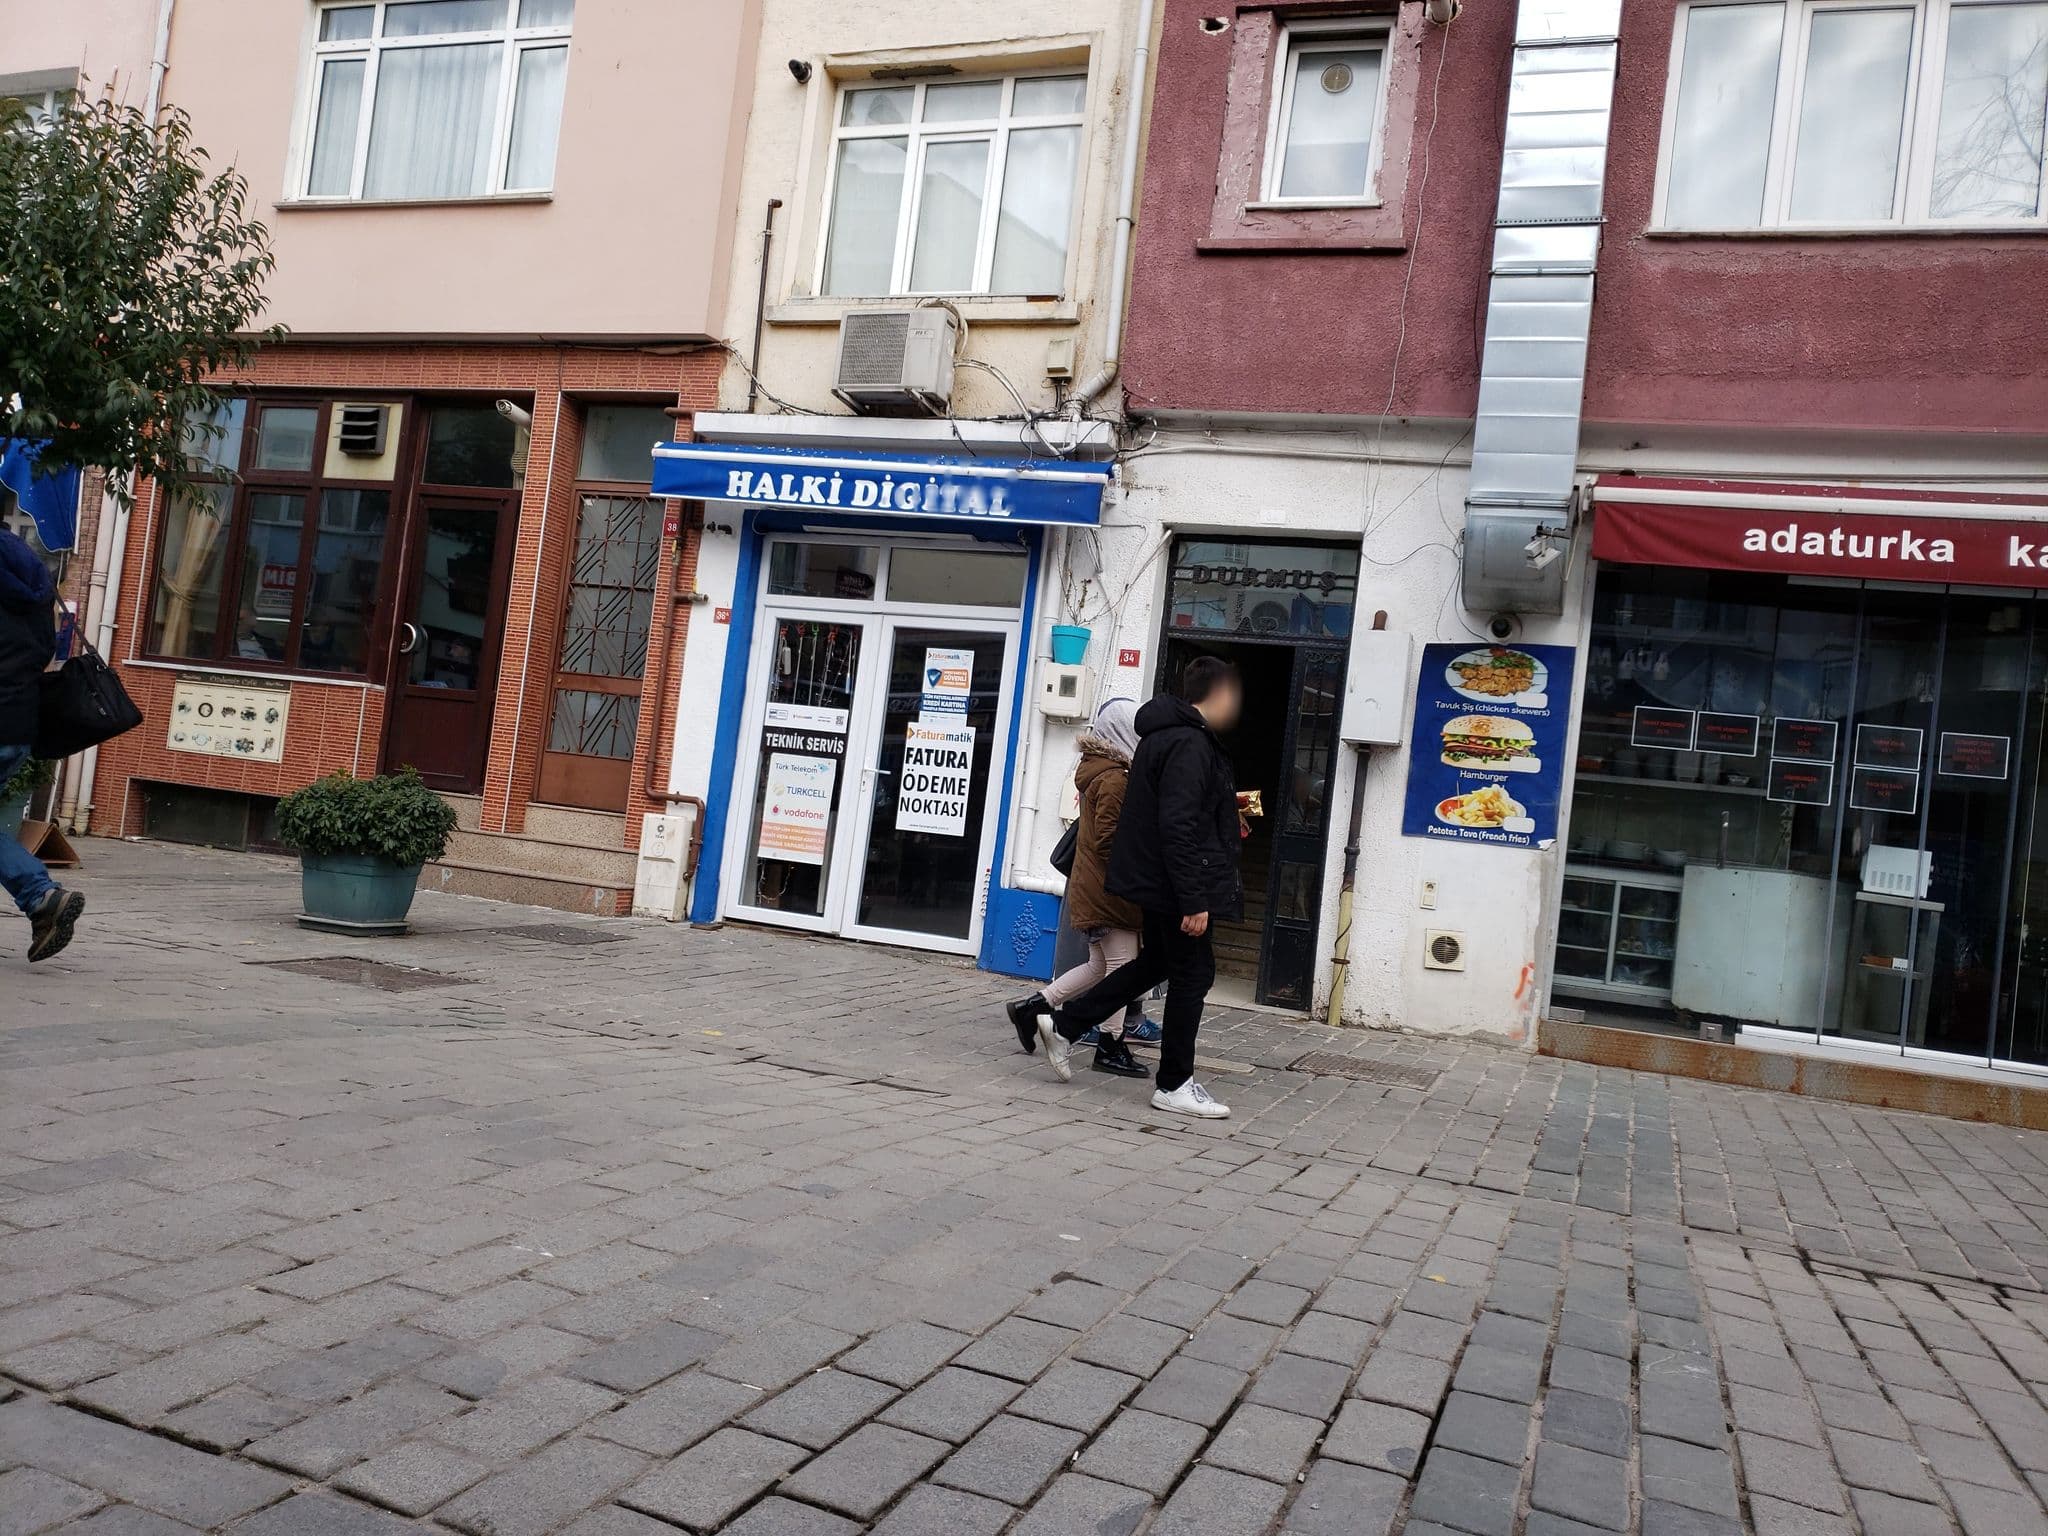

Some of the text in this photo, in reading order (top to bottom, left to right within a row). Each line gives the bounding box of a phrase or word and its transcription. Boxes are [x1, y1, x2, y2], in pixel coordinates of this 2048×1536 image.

[726, 470, 1011, 516] HALKİ DİGİTAL
[667, 523, 677, 531] 38
[1743, 523, 1955, 562] adaturka
[1192, 565, 1337, 597] DURMUŞ
[1123, 652, 1135, 663] 34
[1435, 700, 1550, 717] Tavuk Şiş (chicken skewers)
[766, 732, 845, 754] TEKNİK SERVİS
[916, 729, 972, 743] Faturamatik
[905, 747, 968, 769] FATURA
[776, 762, 818, 773] Türk Telekom
[903, 768, 967, 796] ÖDEME
[1460, 770, 1508, 782] Hamburger
[786, 786, 827, 799] TURKCELL
[784, 808, 824, 819] vodafone
[899, 797, 964, 817] NOKTASI
[1479, 830, 1507, 841] (French
[1508, 833, 1530, 846] fries)
